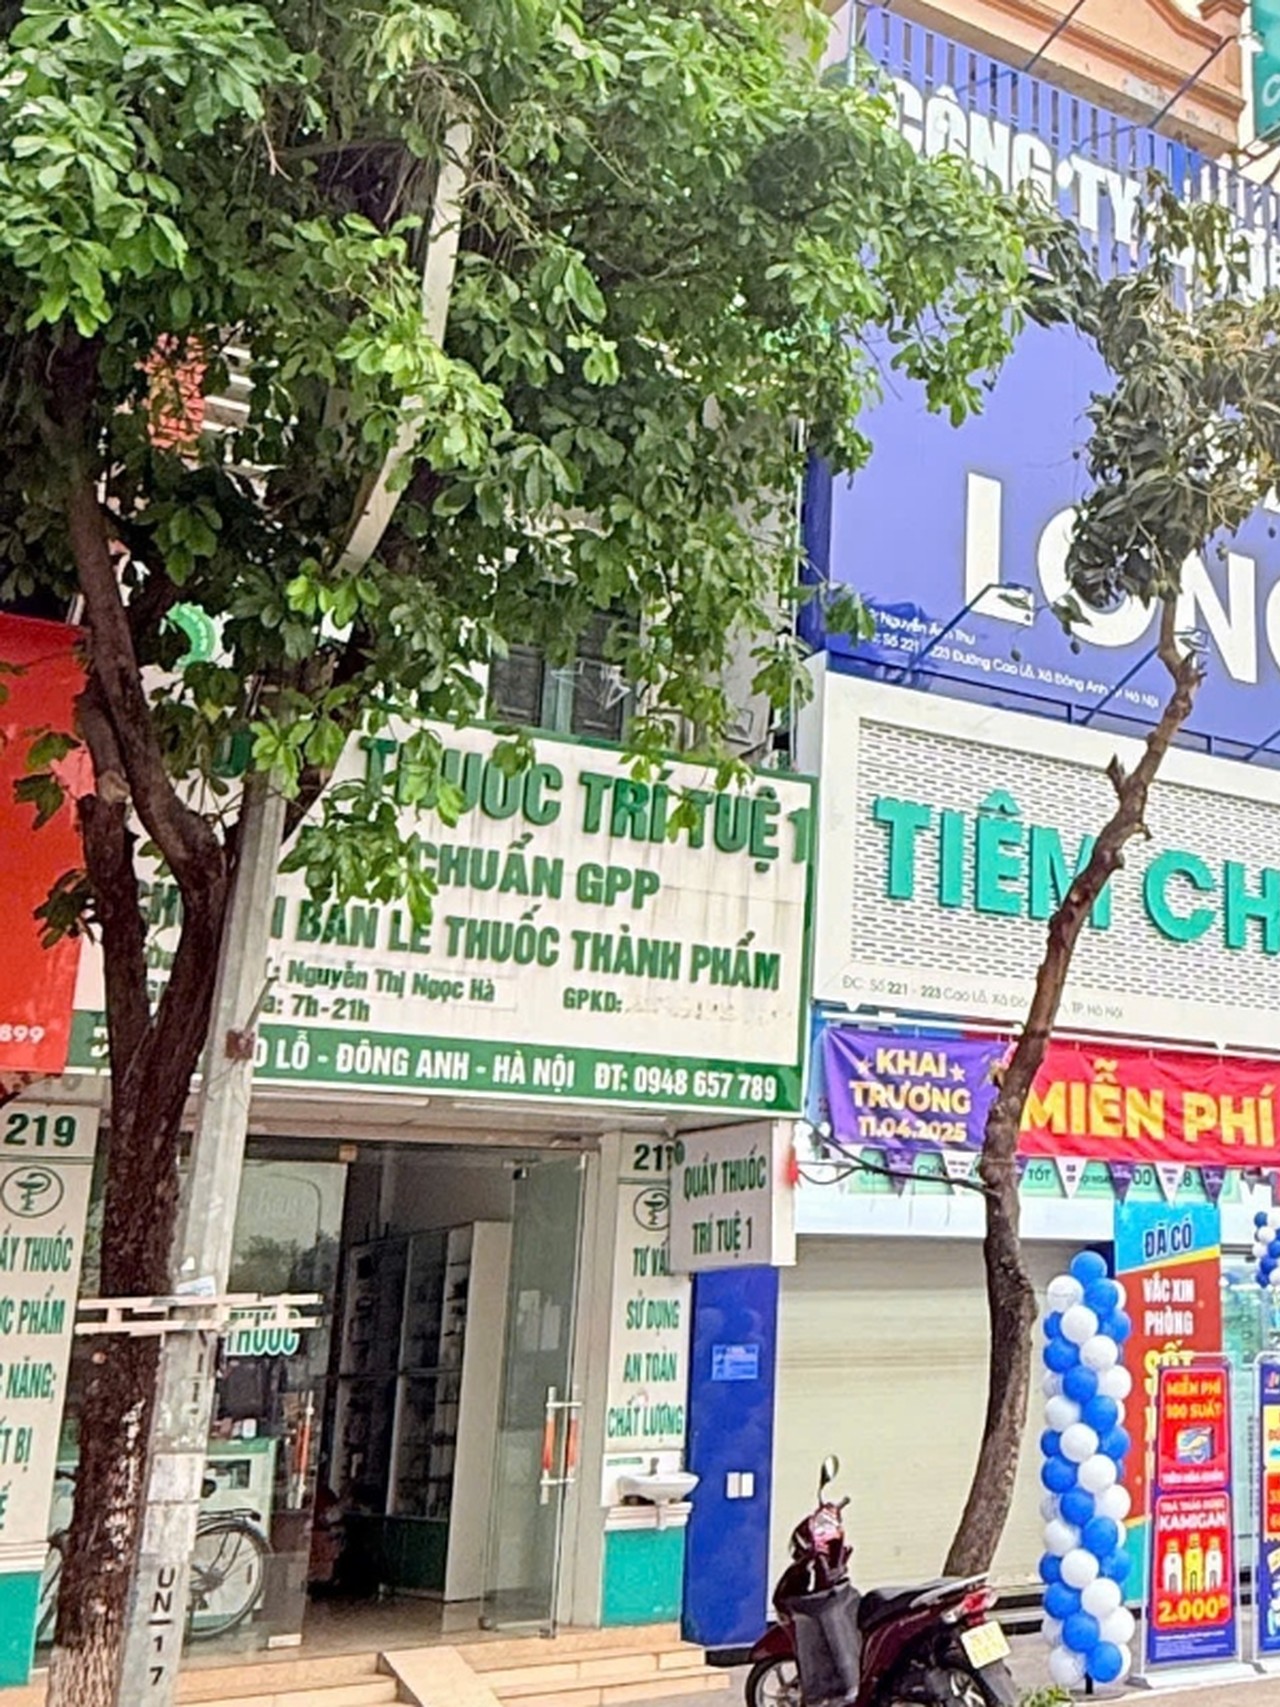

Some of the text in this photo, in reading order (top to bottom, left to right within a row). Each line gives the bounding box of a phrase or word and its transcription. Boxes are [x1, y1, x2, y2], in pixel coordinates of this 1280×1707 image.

[877, 76, 1143, 245] CÔNG TY
[992, 658, 1018, 676] Cao
[579, 768, 674, 844] TRÍ
[677, 786, 780, 873] TUỆ
[413, 832, 661, 910] CHUẨN GPP
[873, 789, 1111, 930] TIÊM
[445, 903, 560, 967] THUỐC
[571, 923, 682, 981] THÀNH
[689, 930, 781, 992] PHẨM
[286, 959, 368, 990] Nguyễn
[374, 968, 407, 999] Thị
[411, 972, 464, 1004] Ngọc
[469, 978, 495, 1003] Hà
[562, 986, 624, 1014] GPKD:
[887, 981, 908, 996] 221
[921, 985, 942, 999] 223
[943, 986, 971, 1002] Cao
[290, 993, 371, 1023] 7h-21h
[275, 1030, 310, 1070] LỖ
[335, 1037, 408, 1075] ĐÔNG
[416, 1050, 469, 1081] ANH
[492, 1043, 527, 1084] HÀ
[533, 1053, 576, 1093] NỘI
[594, 1062, 629, 1092] ĐT:
[633, 1065, 688, 1096] 0948
[693, 1069, 735, 1100] 657
[738, 1073, 777, 1103] 789
[876, 1047, 947, 1078] KHAI
[849, 1079, 972, 1115] TRƯƠNG
[1017, 1057, 1165, 1142] MIỄN
[1182, 1084, 1277, 1149] PHÍ
[4, 1112, 77, 1148] 219
[858, 1114, 968, 1143] 11.04.2025
[721, 1145, 767, 1190] THUỐC
[23, 1223, 74, 1273] THUỐC
[692, 1210, 753, 1259] TRÍ TUỆ 1
[1143, 1215, 1193, 1259] ĐÃ CÓ
[17, 1284, 66, 1335] PHẨM
[1142, 1271, 1195, 1304] VẮC XIN
[1143, 1304, 1194, 1337] PHÒNG
[623, 1346, 678, 1384] AN TOÀN
[14, 1426, 33, 1472] BỊ
